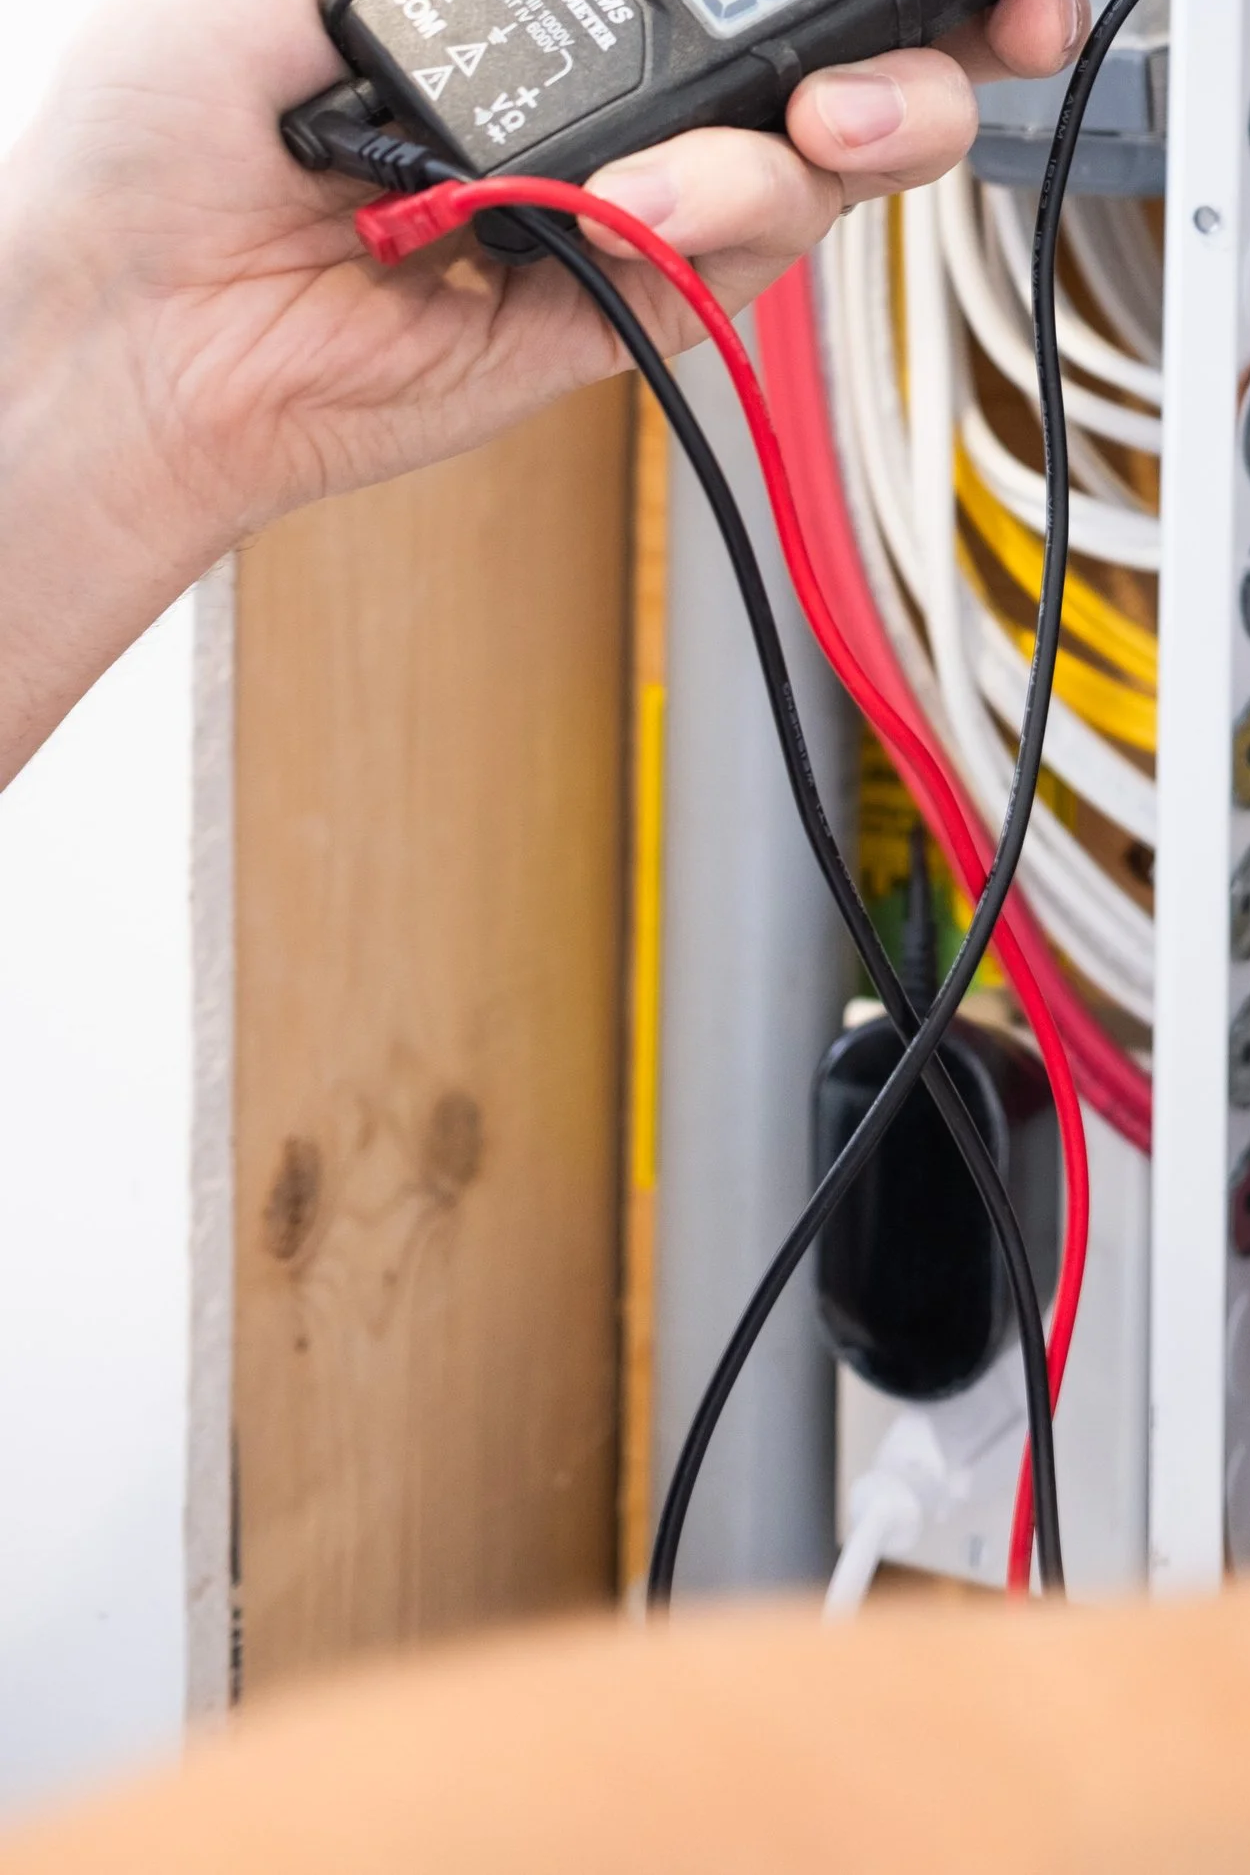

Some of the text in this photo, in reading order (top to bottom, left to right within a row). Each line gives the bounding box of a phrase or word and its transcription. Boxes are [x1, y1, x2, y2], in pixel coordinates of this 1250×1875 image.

[514, 5, 534, 23] IV
[525, 22, 560, 54] 600V
[536, 6, 575, 48] 1000V
